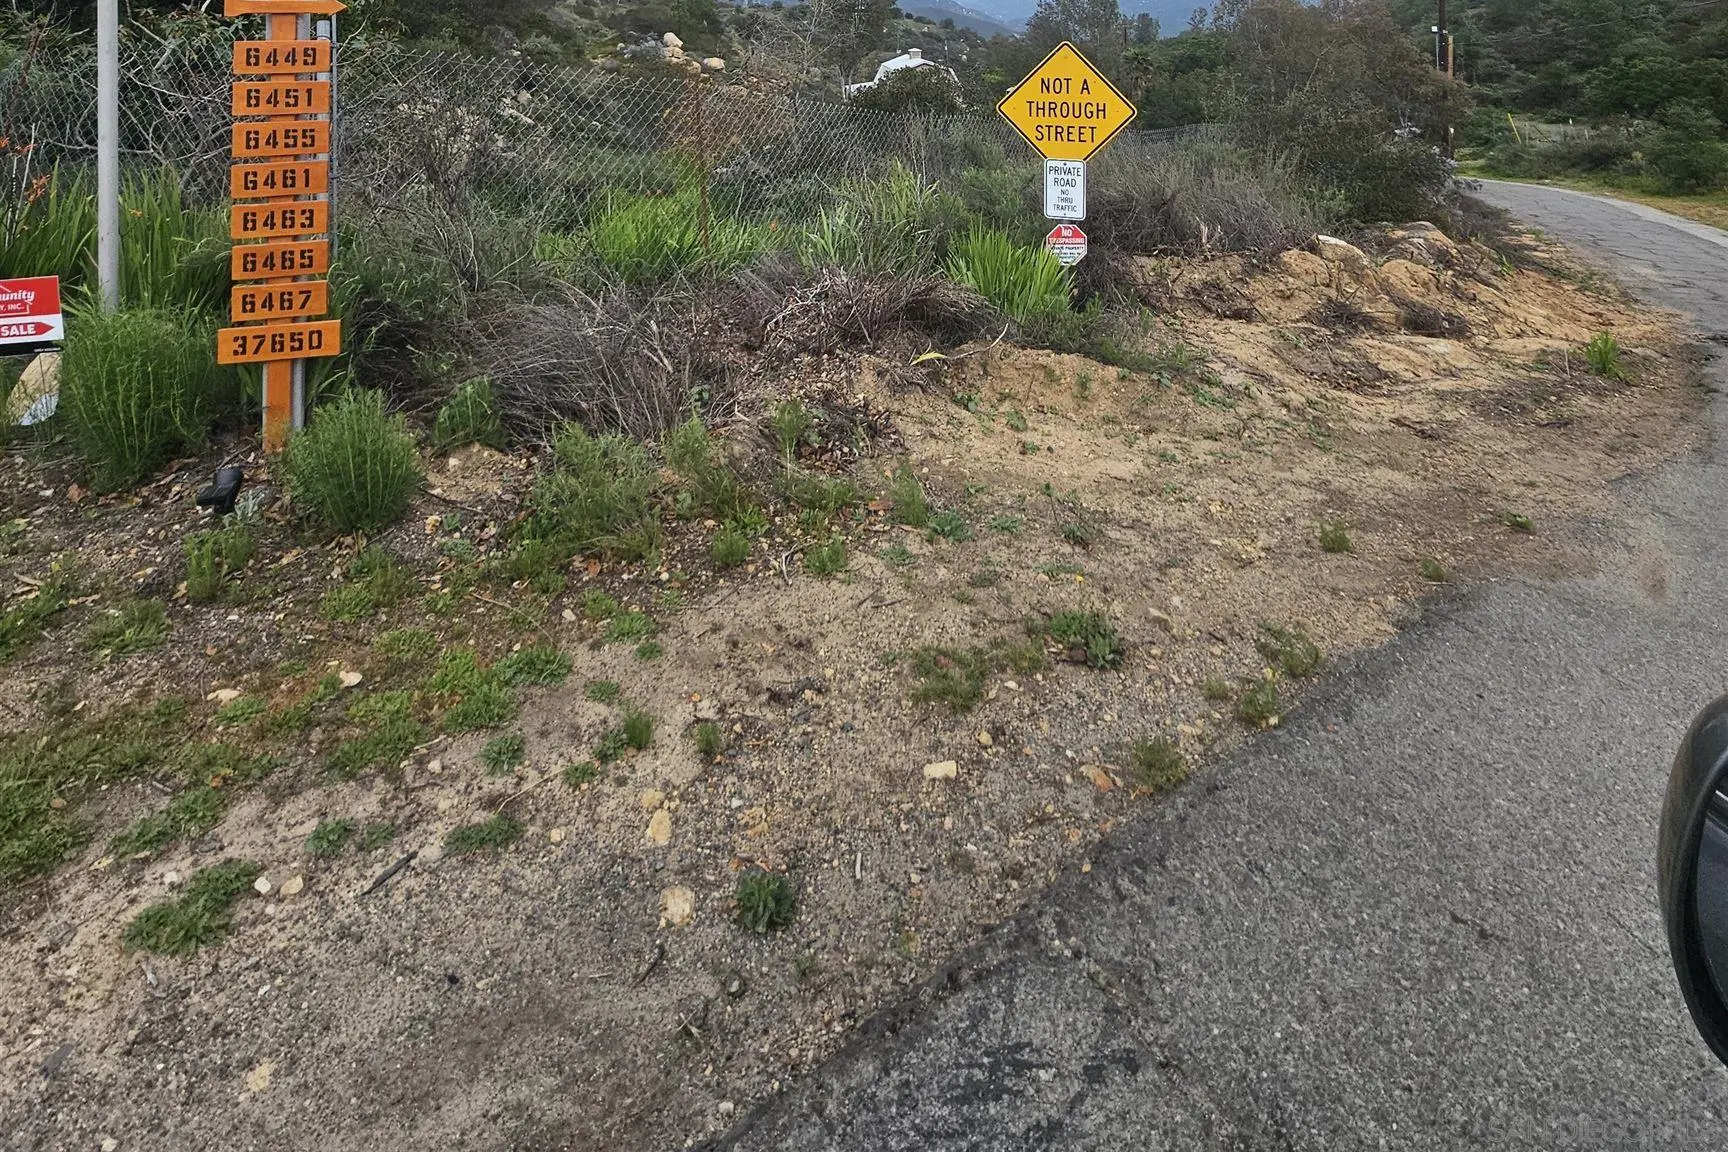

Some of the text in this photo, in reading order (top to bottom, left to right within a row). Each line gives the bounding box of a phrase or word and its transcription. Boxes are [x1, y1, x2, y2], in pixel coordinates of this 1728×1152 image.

[245, 47, 317, 67] 6449
[1040, 77, 1091, 95] NOT A
[246, 88, 313, 108] 6451
[1026, 100, 1107, 119] THROUGH
[245, 128, 315, 150] 6455
[1035, 124, 1097, 143] STREET
[243, 168, 310, 191] 6461
[1048, 165, 1082, 176] PRIVATE
[1053, 177, 1077, 188] ROAD
[1053, 203, 1078, 212] TRAFFIC
[1057, 196, 1074, 204] THRU
[242, 208, 315, 232] 6463
[1061, 228, 1073, 237] NO
[242, 248, 314, 273] 6465
[0, 289, 35, 302] unity
[241, 289, 312, 314] 6467
[8, 302, 24, 311] INC.
[1, 323, 36, 337] SALE
[232, 329, 323, 356] 37650
